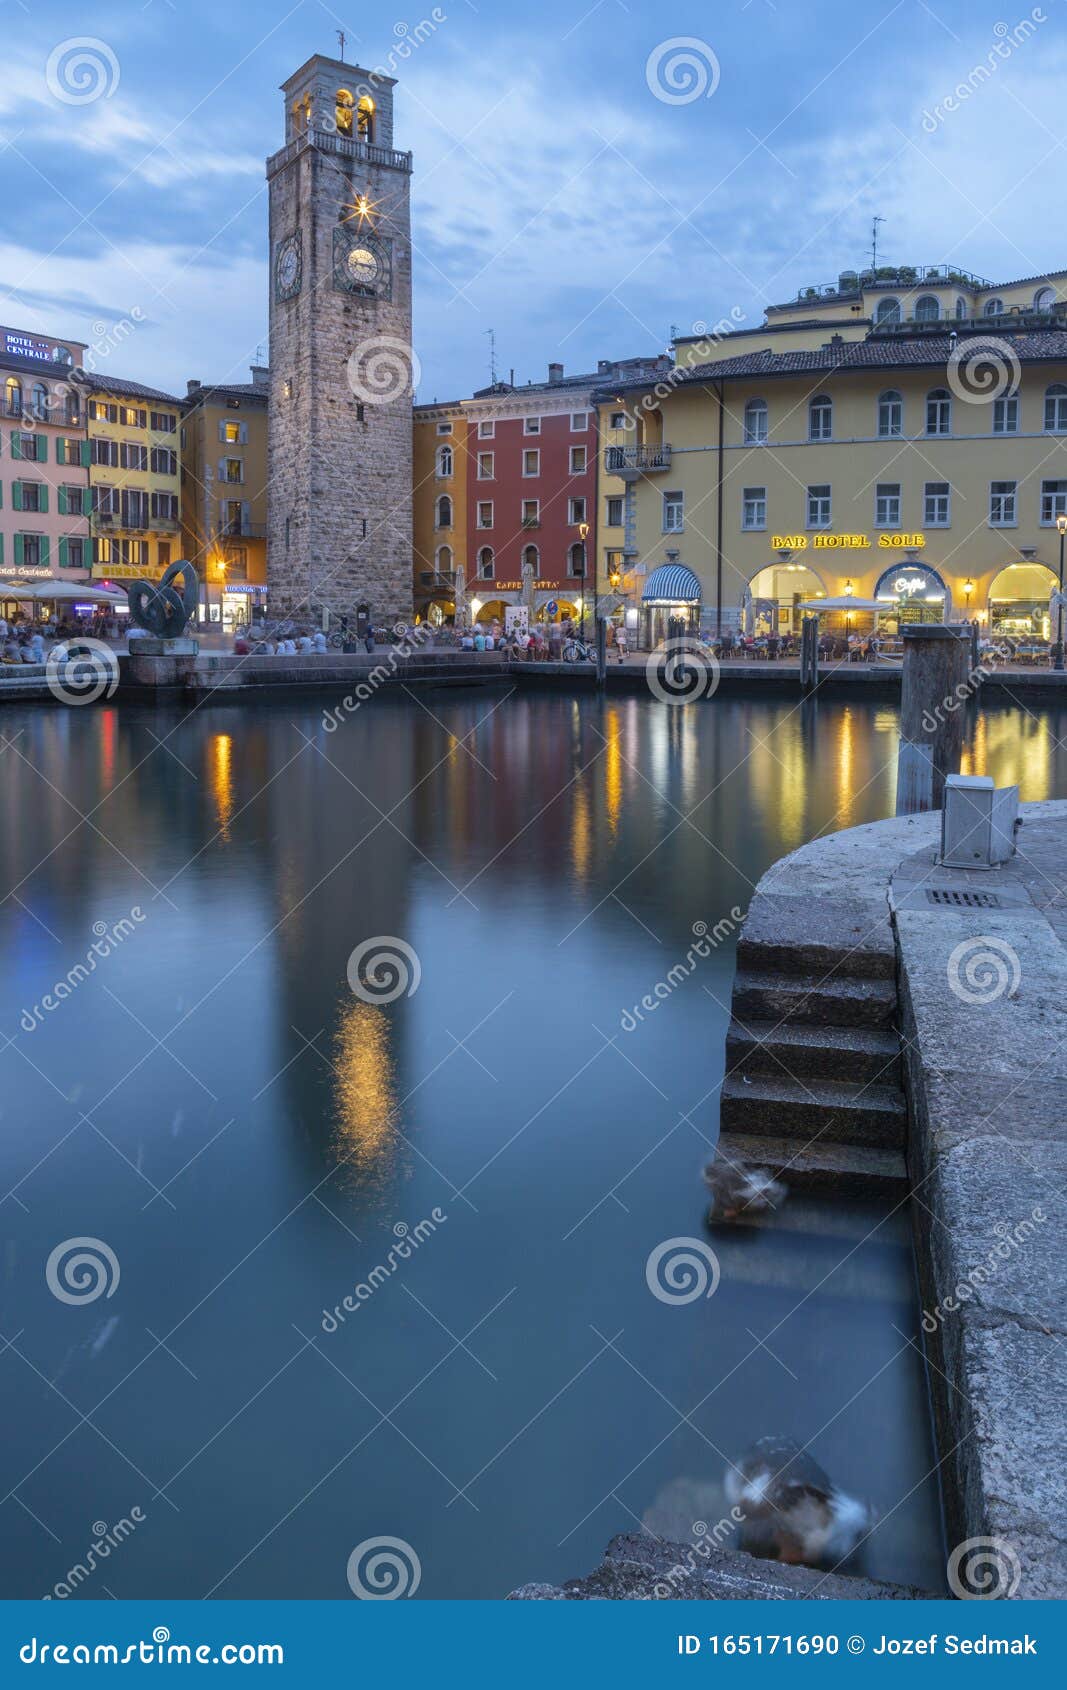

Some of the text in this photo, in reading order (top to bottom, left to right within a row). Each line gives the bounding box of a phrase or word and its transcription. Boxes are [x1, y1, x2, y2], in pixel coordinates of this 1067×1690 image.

[6, 335, 34, 347] HOTEL
[6, 345, 50, 360] CENTRALE
[772, 534, 925, 549] BAR HOTEL SOLE
